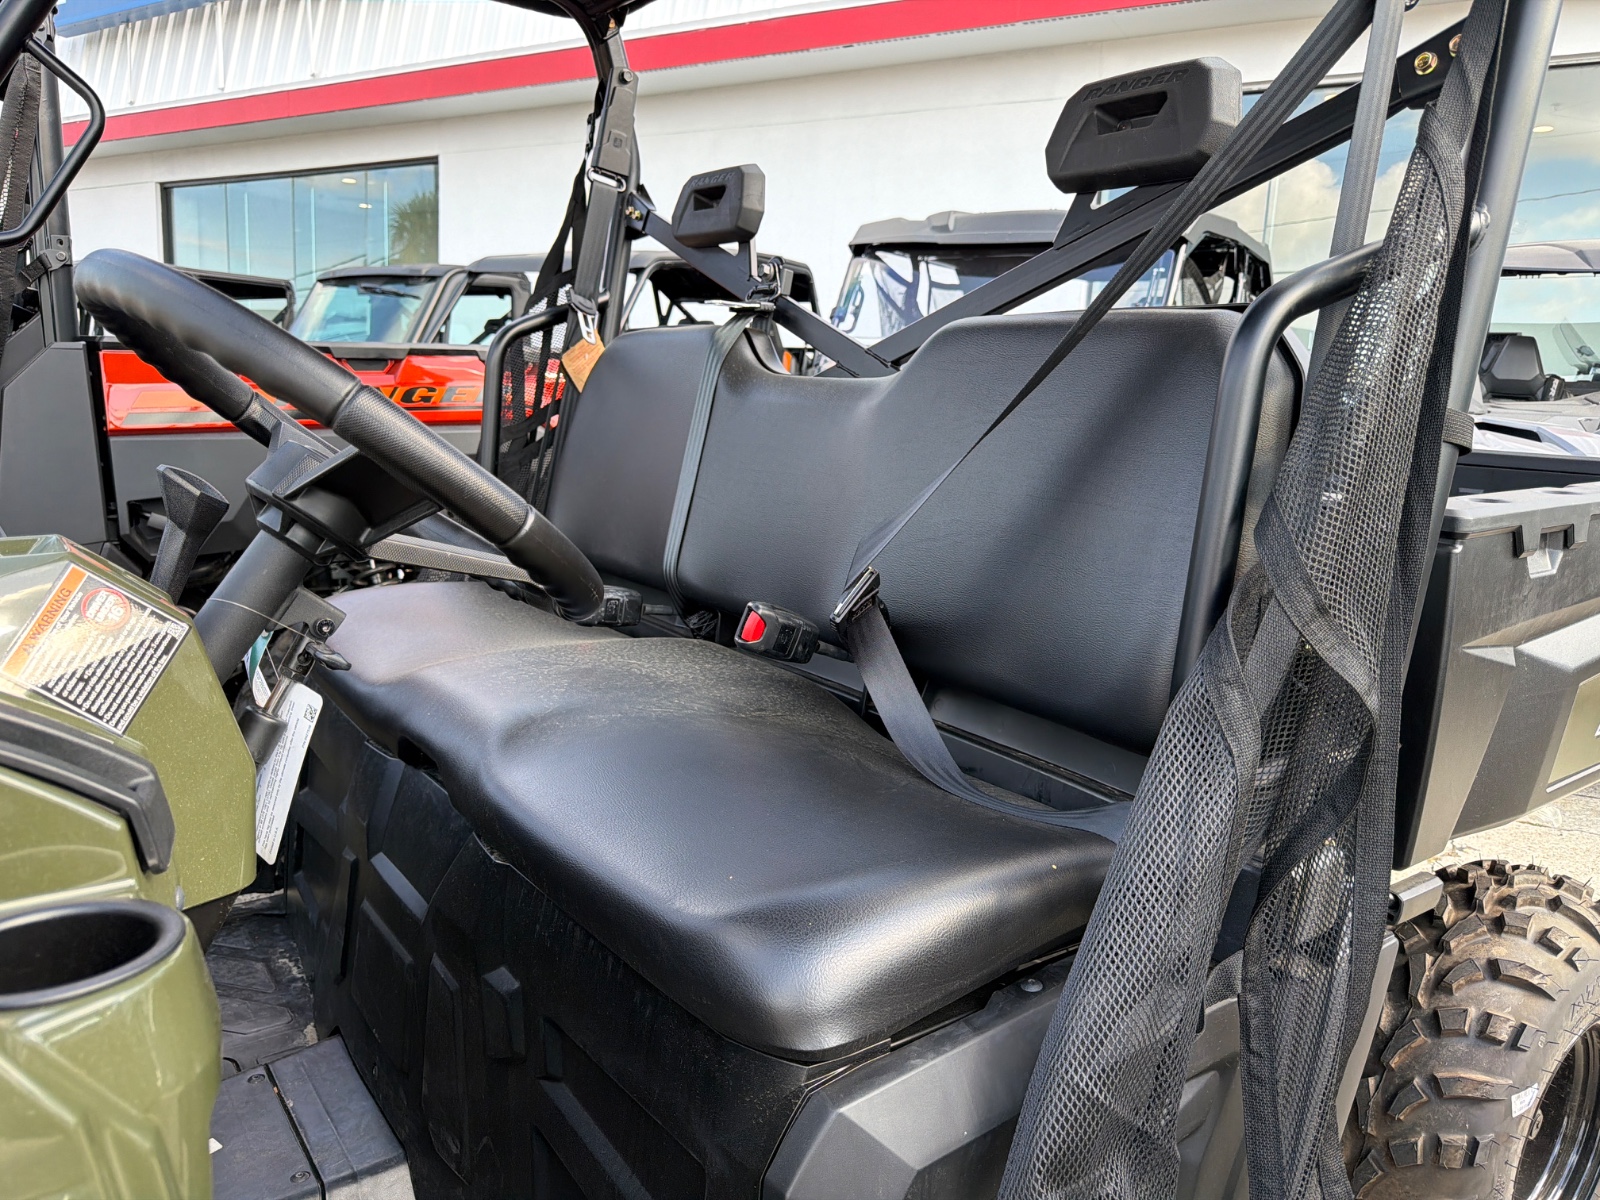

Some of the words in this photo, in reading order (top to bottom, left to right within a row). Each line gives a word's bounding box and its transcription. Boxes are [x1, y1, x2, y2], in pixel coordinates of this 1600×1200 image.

[1082, 69, 1189, 101] RANGER
[689, 172, 735, 188] RANGER
[29, 585, 72, 642] WARNING
[84, 589, 109, 619] DRIVER
[93, 594, 117, 623] UNDER
[106, 604, 125, 622] 16
